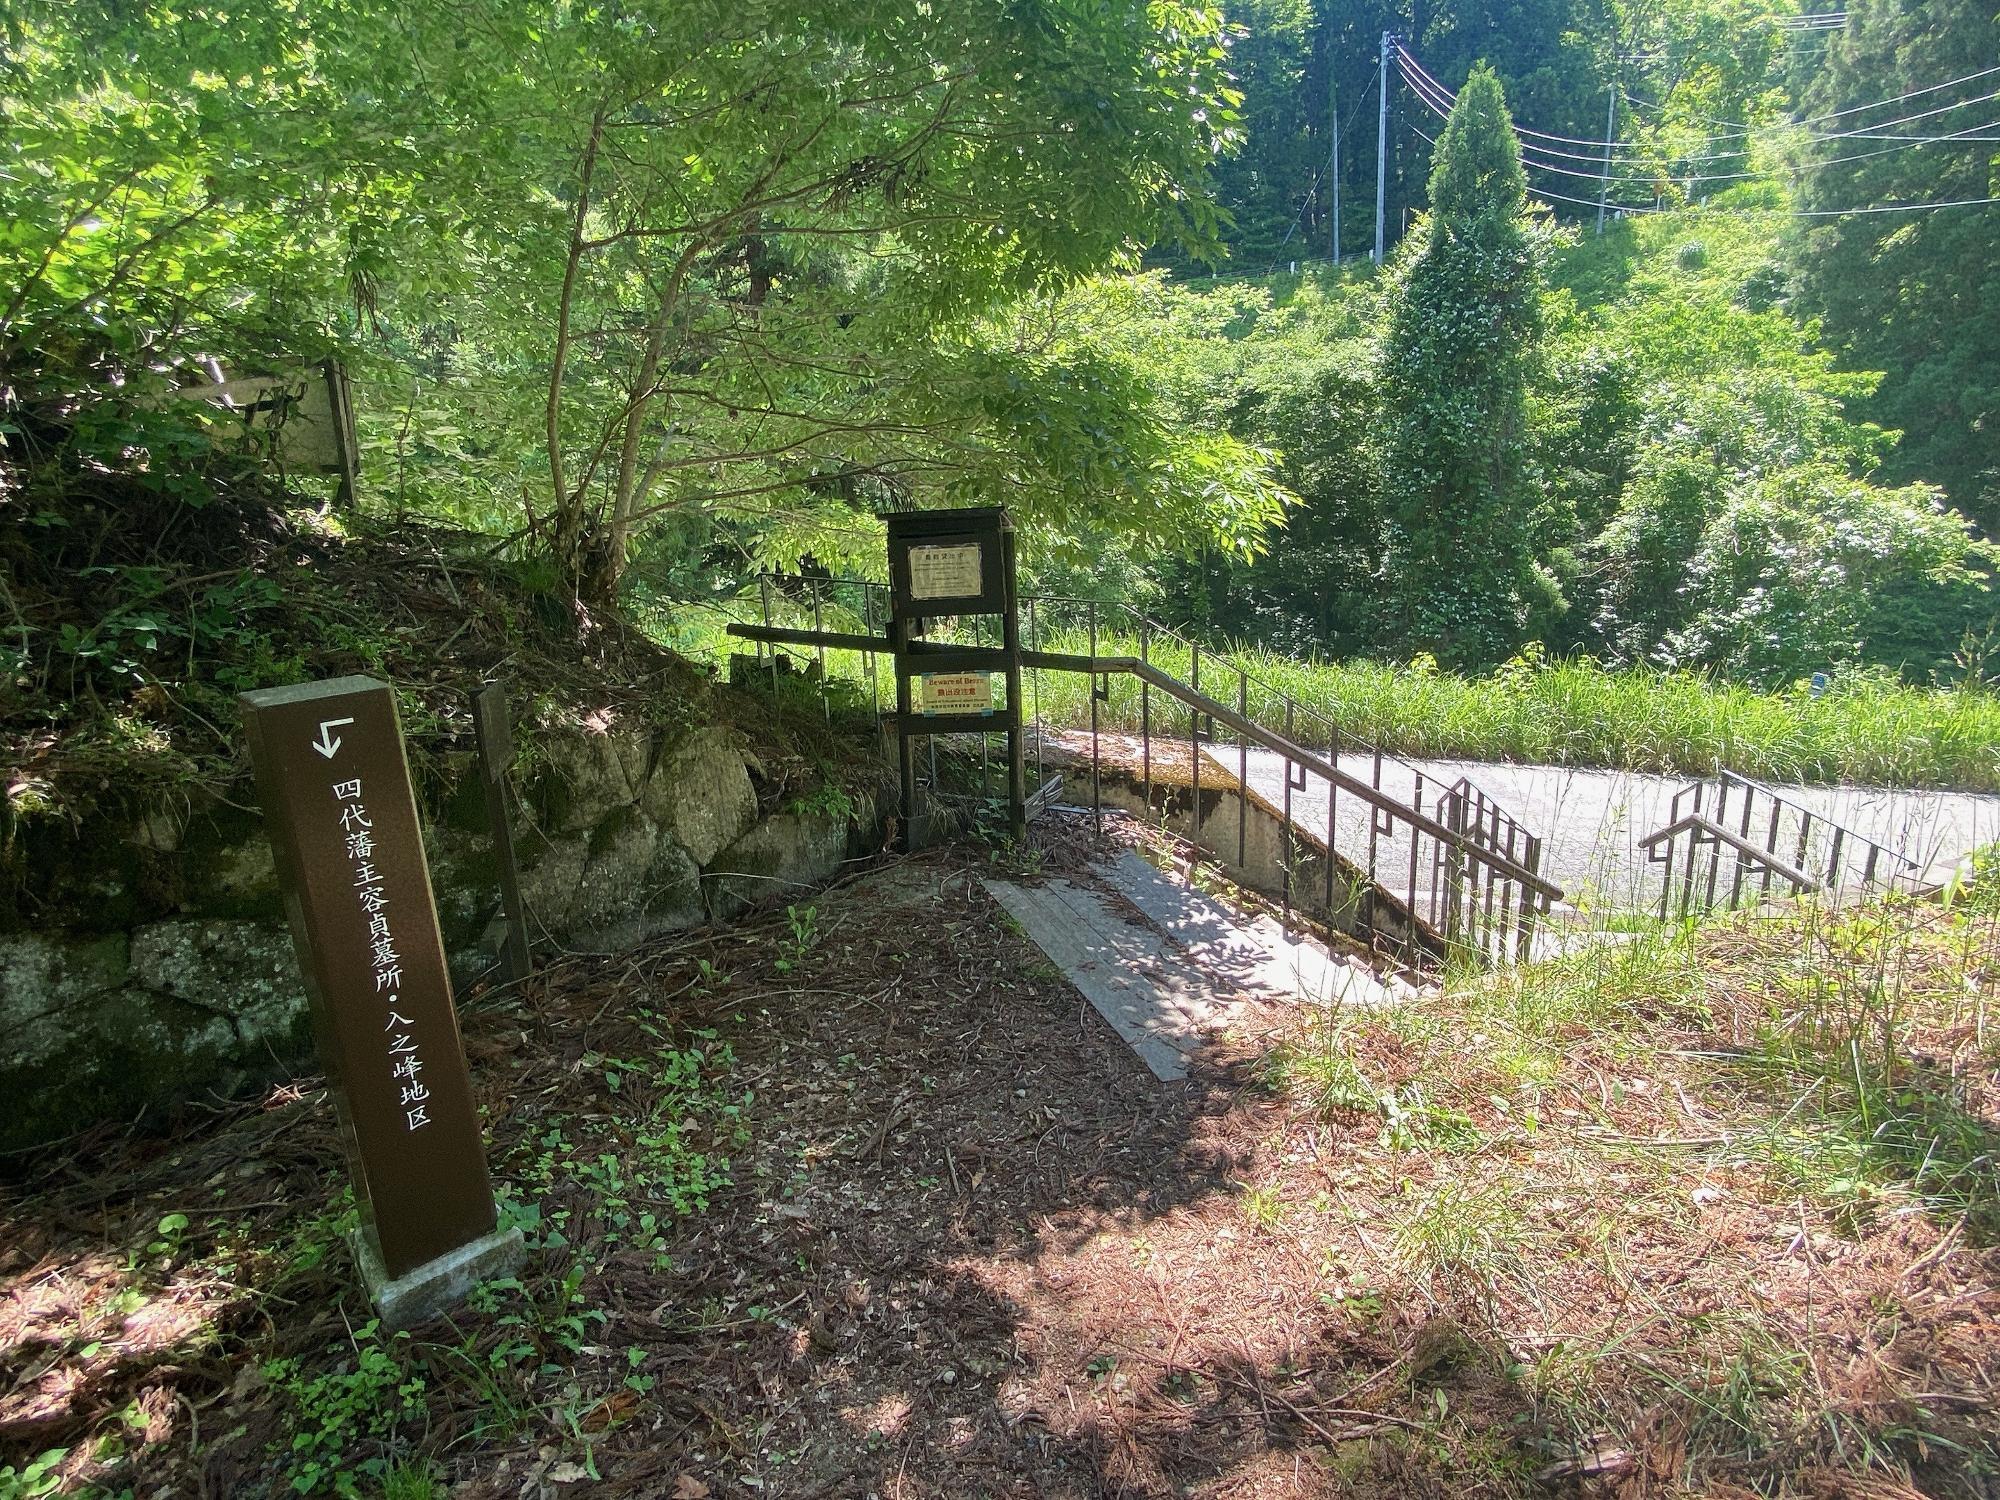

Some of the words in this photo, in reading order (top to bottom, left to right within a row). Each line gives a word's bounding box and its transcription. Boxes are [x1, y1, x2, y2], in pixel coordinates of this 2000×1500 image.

[929, 678, 954, 686] Beware
[955, 677, 963, 685] of
[332, 778, 432, 1131] 四代藩主容貞墓所・入之峰地区
